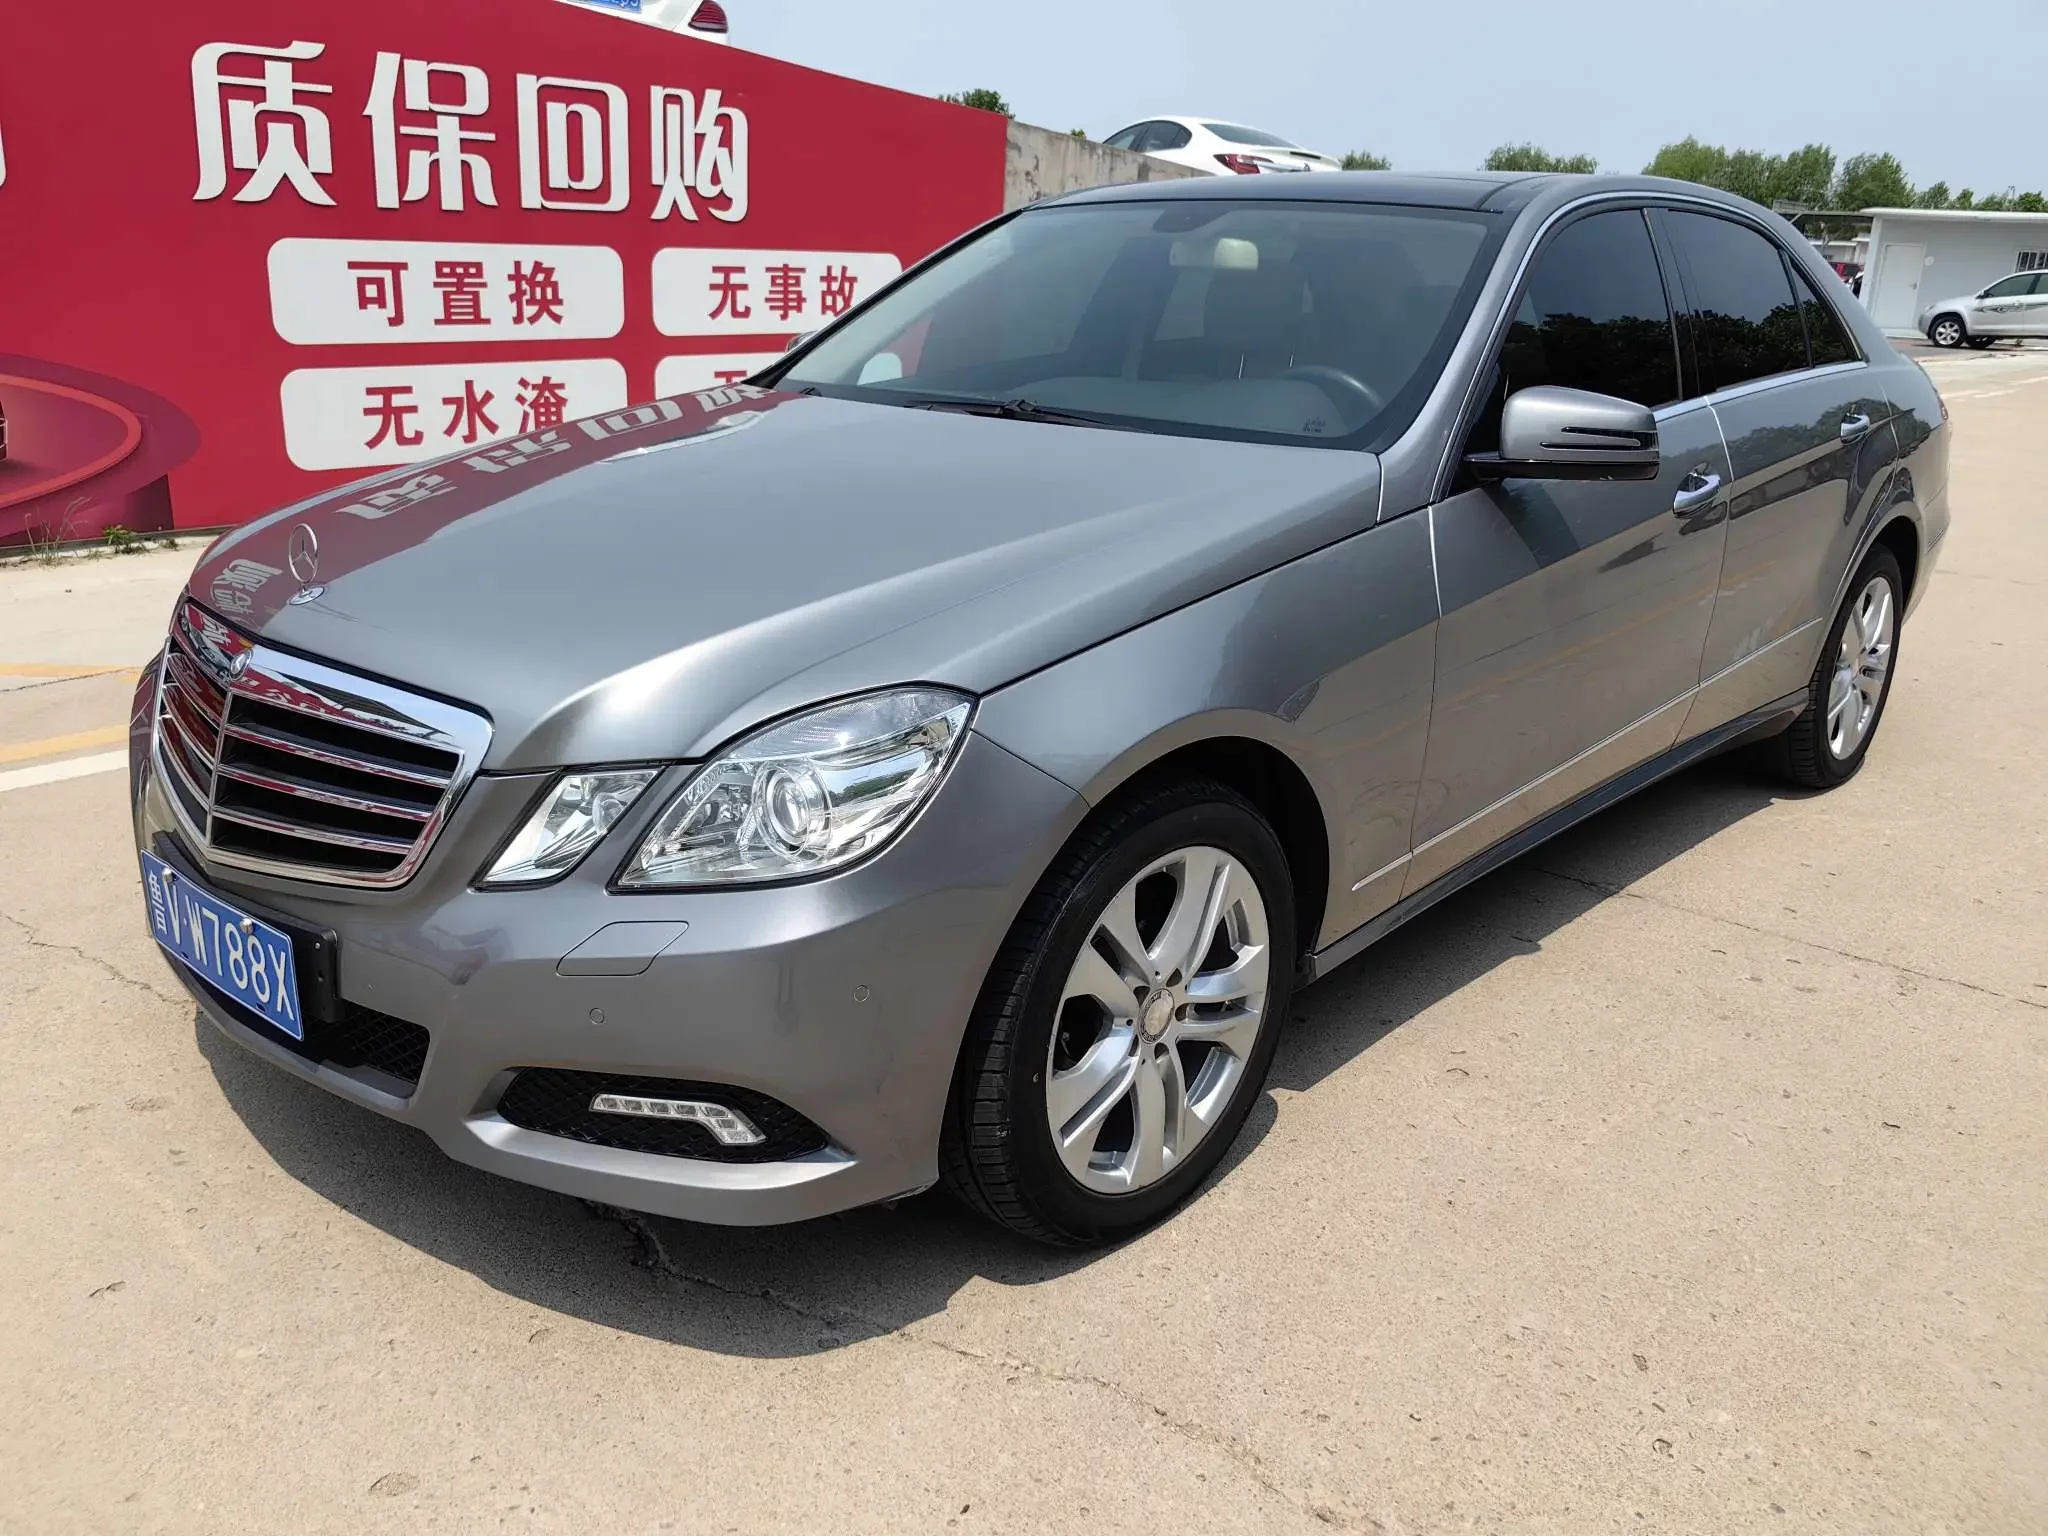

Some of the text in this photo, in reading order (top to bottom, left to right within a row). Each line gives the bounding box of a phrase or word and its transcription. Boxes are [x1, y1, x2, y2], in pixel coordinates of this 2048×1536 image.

[191, 40, 749, 222] 质保回购
[347, 260, 565, 327] 可置换
[708, 263, 859, 322] 无事故
[362, 375, 569, 450] 无水淹
